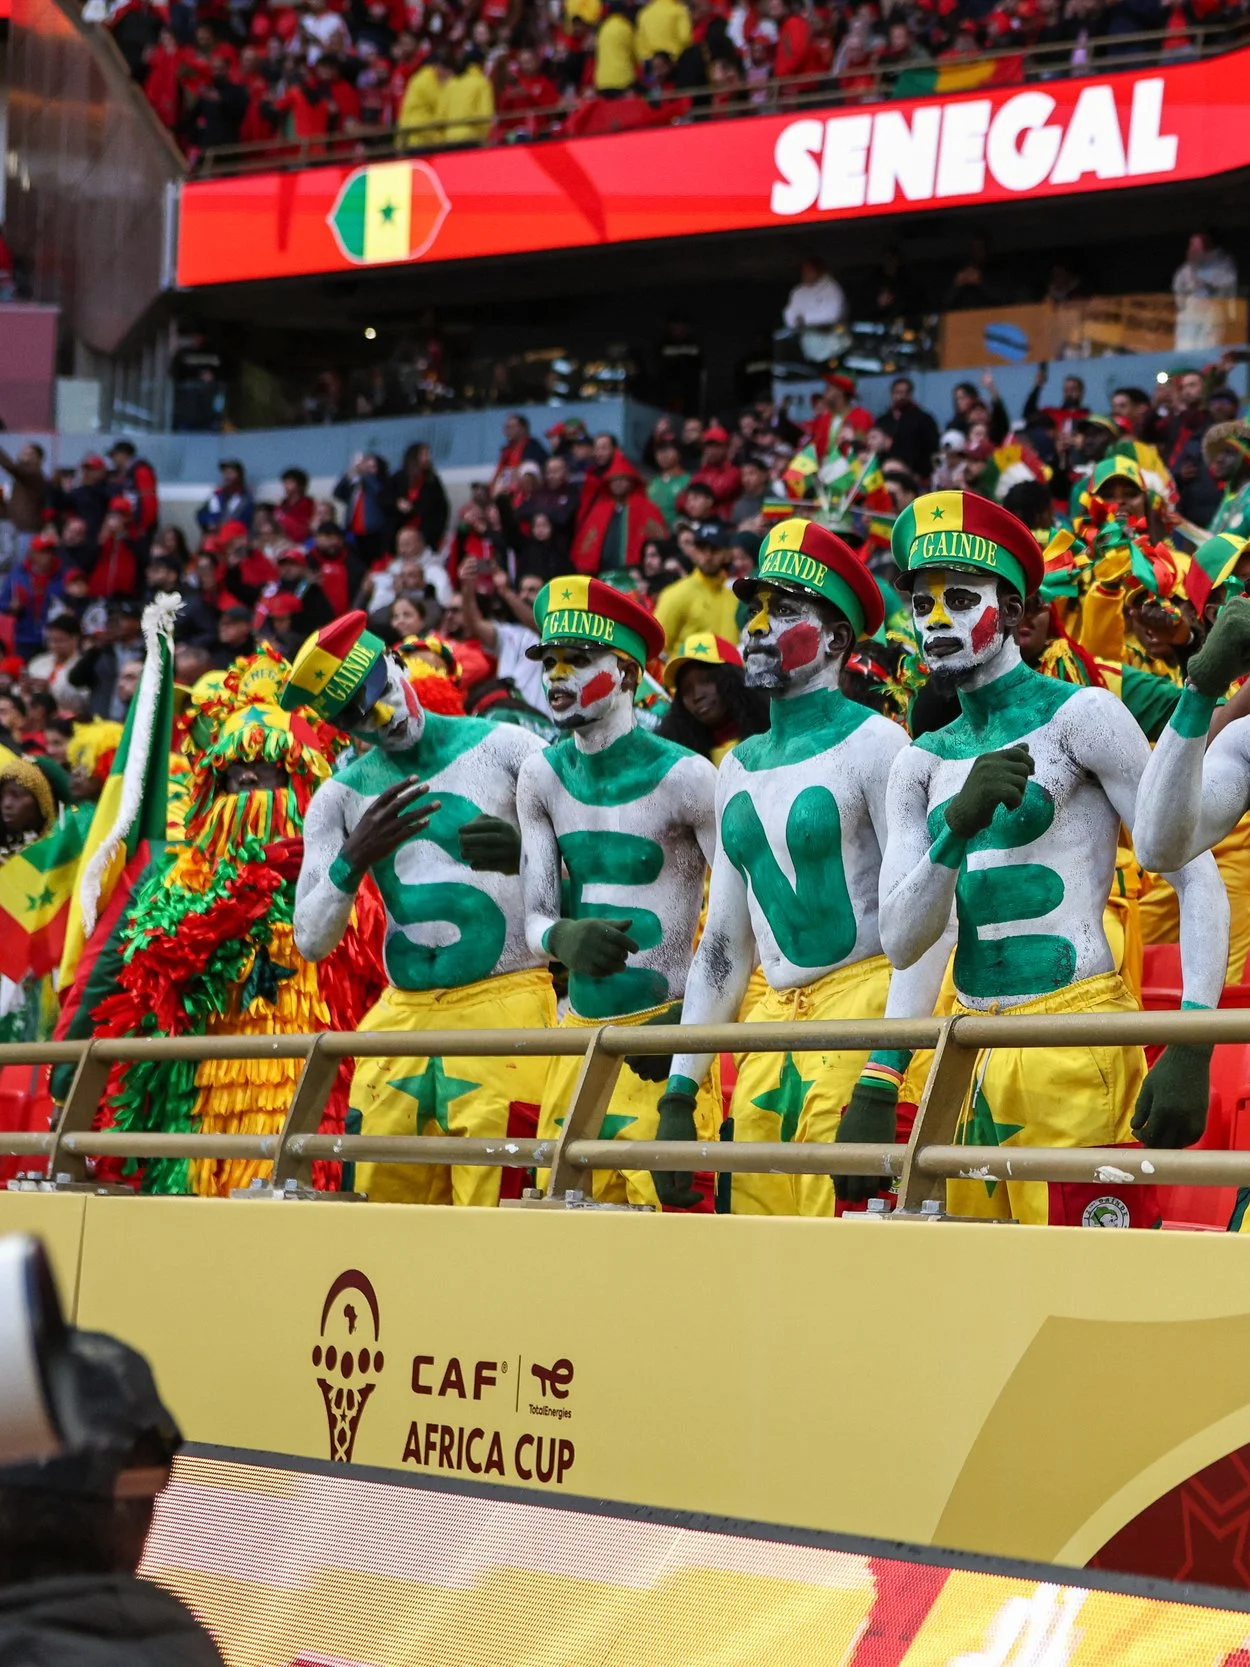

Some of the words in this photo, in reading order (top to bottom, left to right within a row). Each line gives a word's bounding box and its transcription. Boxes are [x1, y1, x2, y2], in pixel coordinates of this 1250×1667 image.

[770, 78, 1178, 215] SENEGAL
[760, 551, 828, 587] GAINDE
[923, 531, 998, 567] GAINDE
[549, 609, 615, 641] GAINDE
[325, 643, 376, 701] GAINDE
[372, 792, 506, 991] S
[558, 830, 669, 1018] E
[721, 785, 857, 967] N
[927, 780, 1077, 998] E
[528, 1403, 572, 1420] TotalEnergies
[402, 1420, 506, 1477] AFRICA
[514, 1433, 576, 1484] CUP
